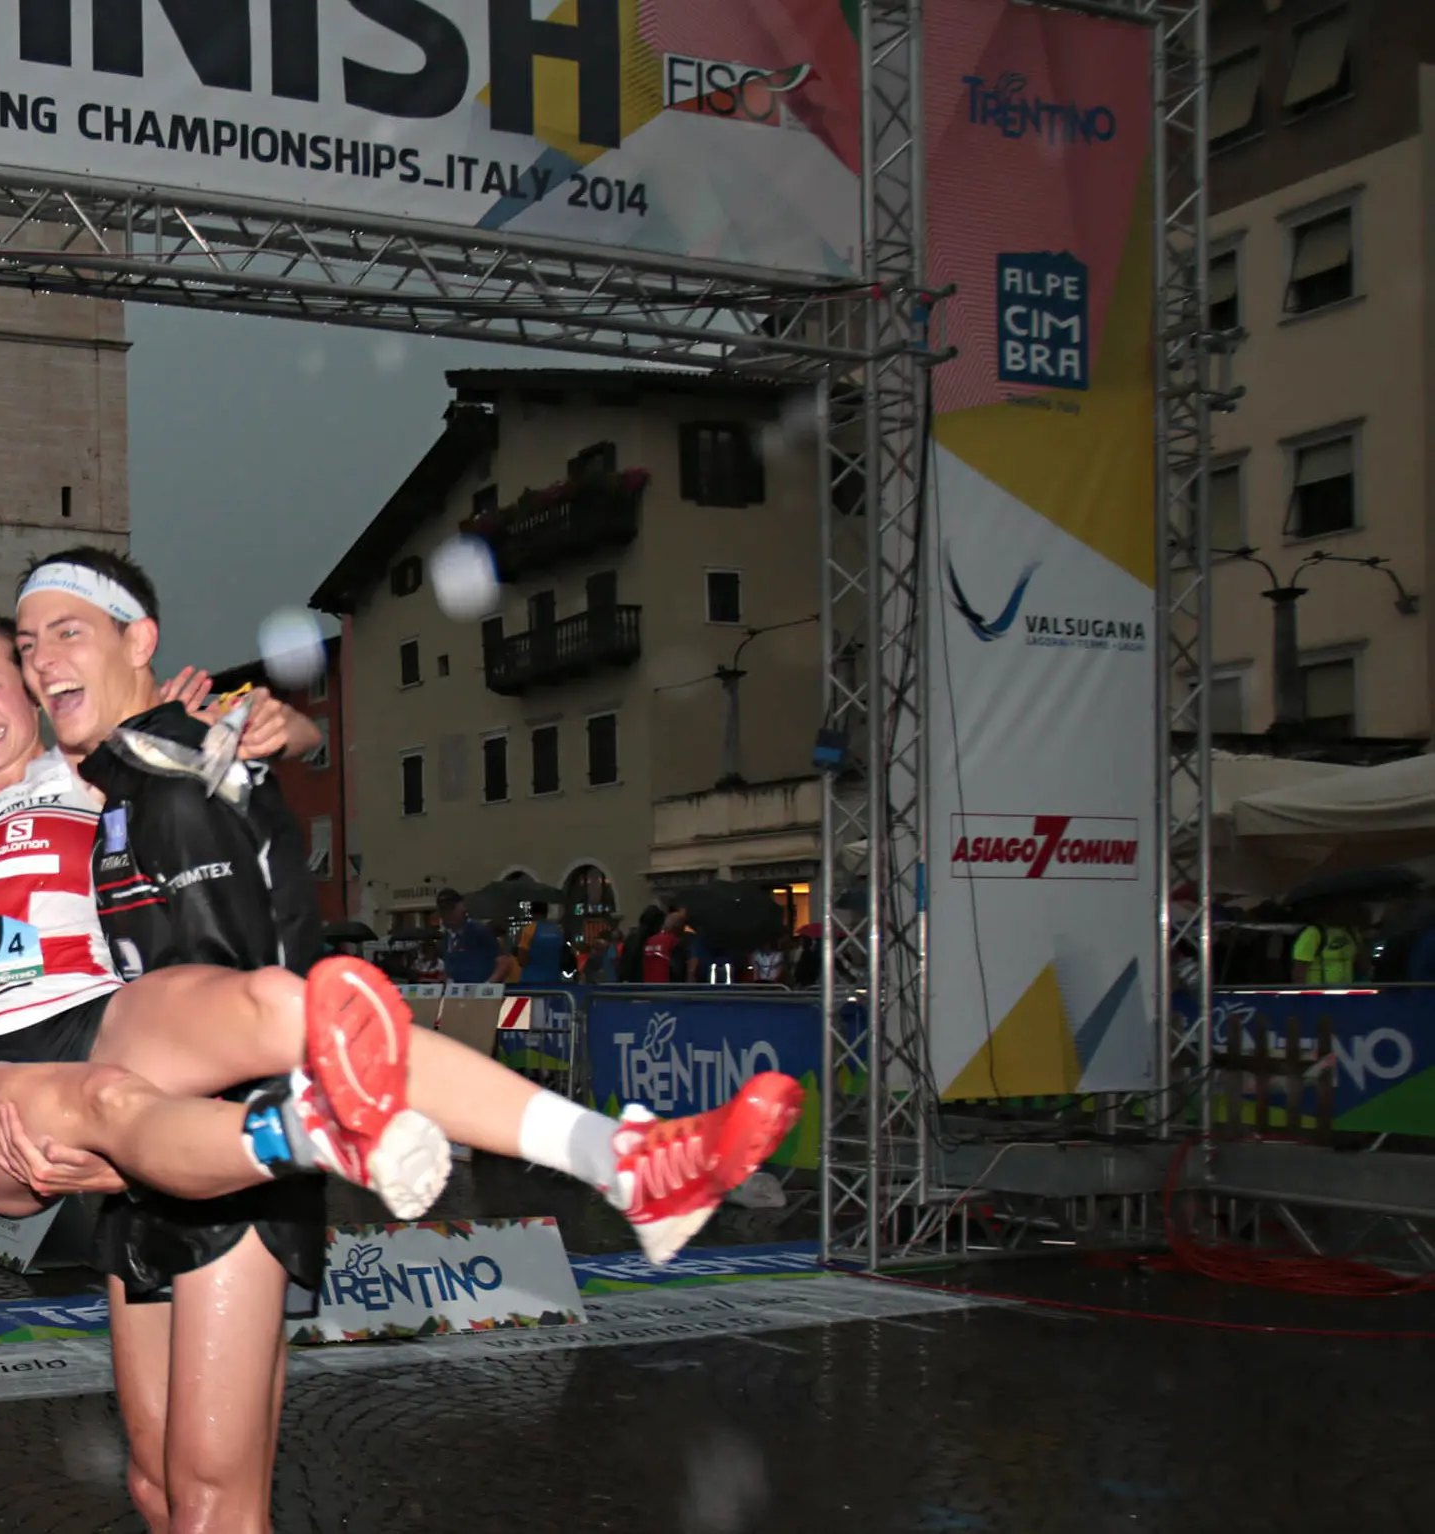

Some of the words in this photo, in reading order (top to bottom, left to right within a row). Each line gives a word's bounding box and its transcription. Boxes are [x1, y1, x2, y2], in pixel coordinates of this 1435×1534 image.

[568, 173, 648, 217] 2014
[1004, 267, 1080, 300] ALPE
[1004, 305, 1081, 344] CIM
[1005, 342, 1081, 380] BRA
[1025, 615, 1145, 640] VALSUGANA
[8, 932, 25, 957] 4
